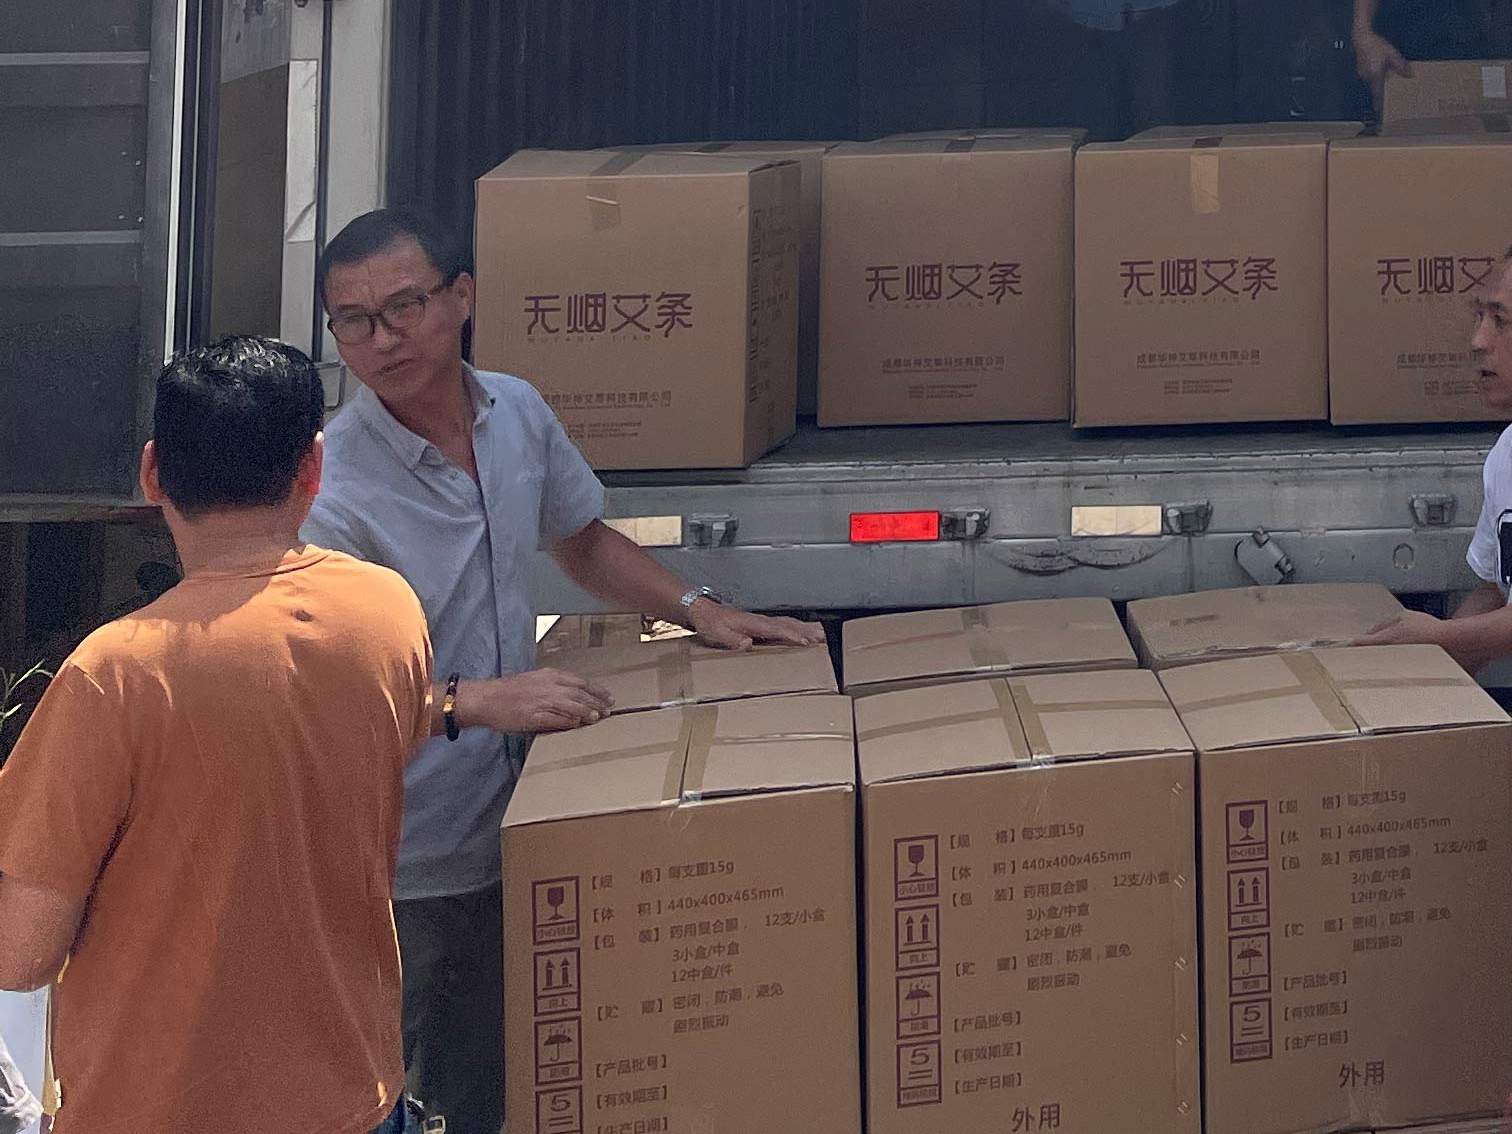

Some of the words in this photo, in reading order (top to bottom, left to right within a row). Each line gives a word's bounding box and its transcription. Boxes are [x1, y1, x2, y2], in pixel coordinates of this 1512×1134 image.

[865, 261, 1023, 305] 无烟艾条
[1120, 256, 1278, 300] 无烟艾条
[1377, 256, 1496, 295] 无烟艾
[524, 291, 693, 338] 无烟艾条
[1347, 817, 1451, 836] 440x400x465mm
[1022, 850, 1132, 871] 440x400x465mm
[668, 887, 784, 911] 440x400x465mm
[1339, 1060, 1384, 1088] 外用
[1012, 1103, 1060, 1132] 外用
